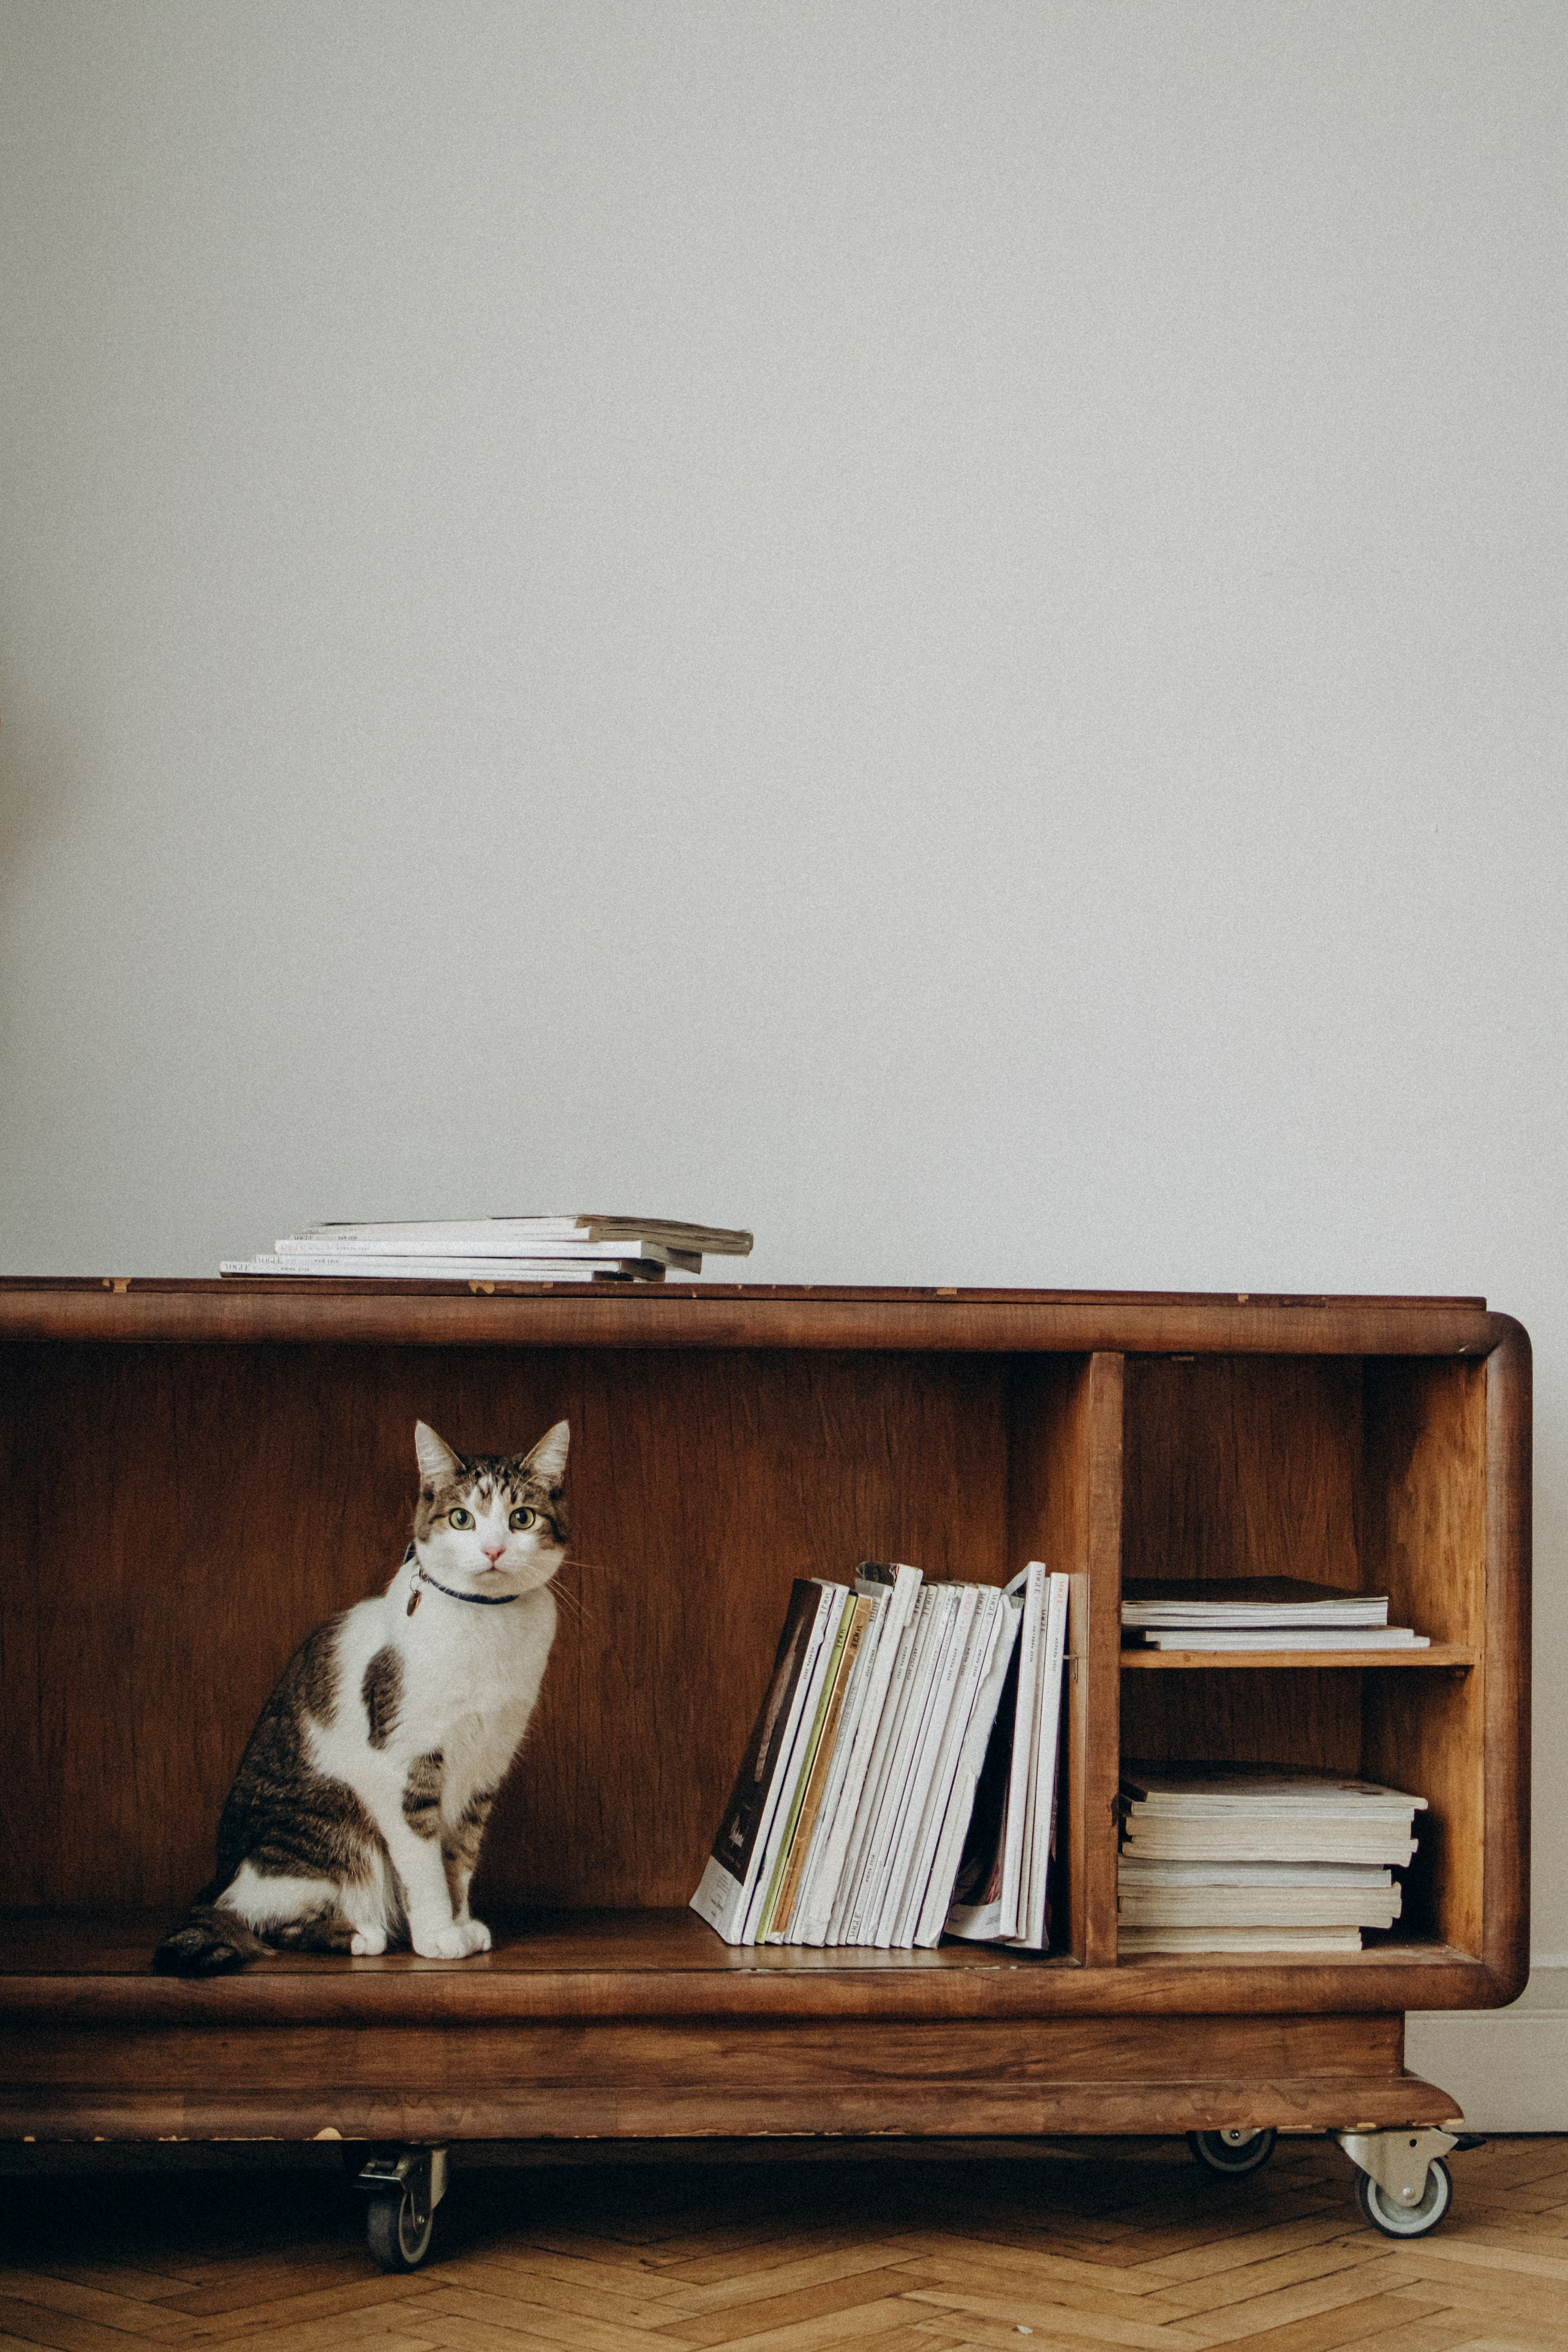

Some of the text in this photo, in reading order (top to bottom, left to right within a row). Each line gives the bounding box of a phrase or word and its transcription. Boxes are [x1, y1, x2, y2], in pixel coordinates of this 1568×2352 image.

[820, 1593, 831, 1616] VOGUE
[922, 1593, 934, 1618] VOGUE
[963, 1593, 974, 1616] VOGUE
[974, 1592, 986, 1616] VOGUE
[987, 1594, 998, 1618] VOGUE
[835, 1628, 846, 1650] VOGUE
[851, 1624, 862, 1649] VOGUE
[850, 1912, 861, 1937] VOGUE
